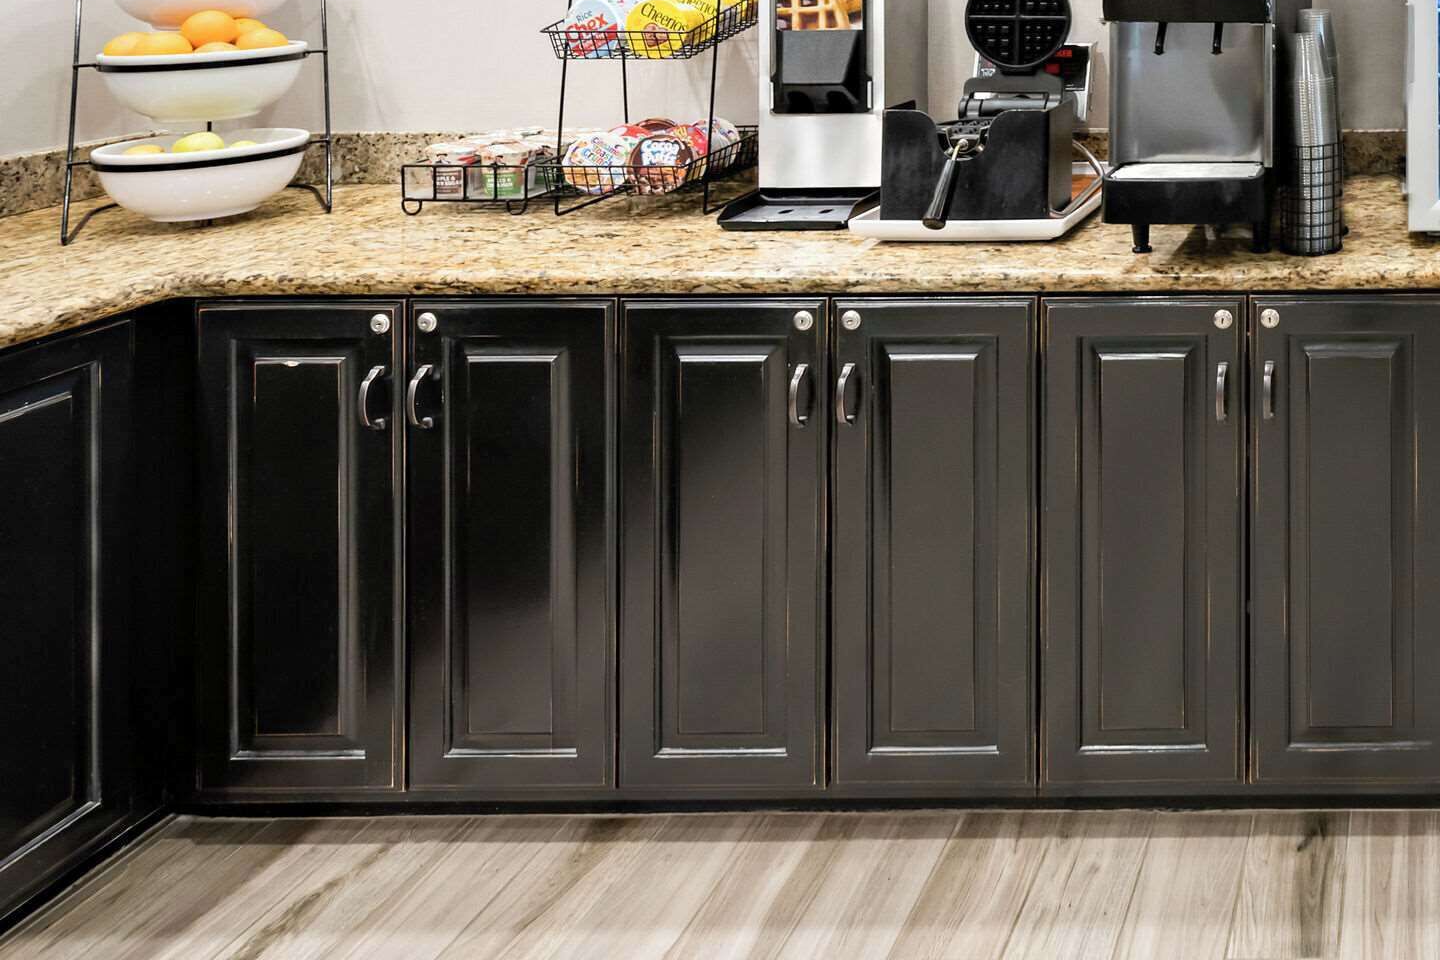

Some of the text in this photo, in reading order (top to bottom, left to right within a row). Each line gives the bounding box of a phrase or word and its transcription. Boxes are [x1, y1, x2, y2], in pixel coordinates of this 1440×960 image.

[565, 14, 609, 43] Chex
[576, 10, 593, 23] Rice
[640, 1, 690, 33] Cheerios
